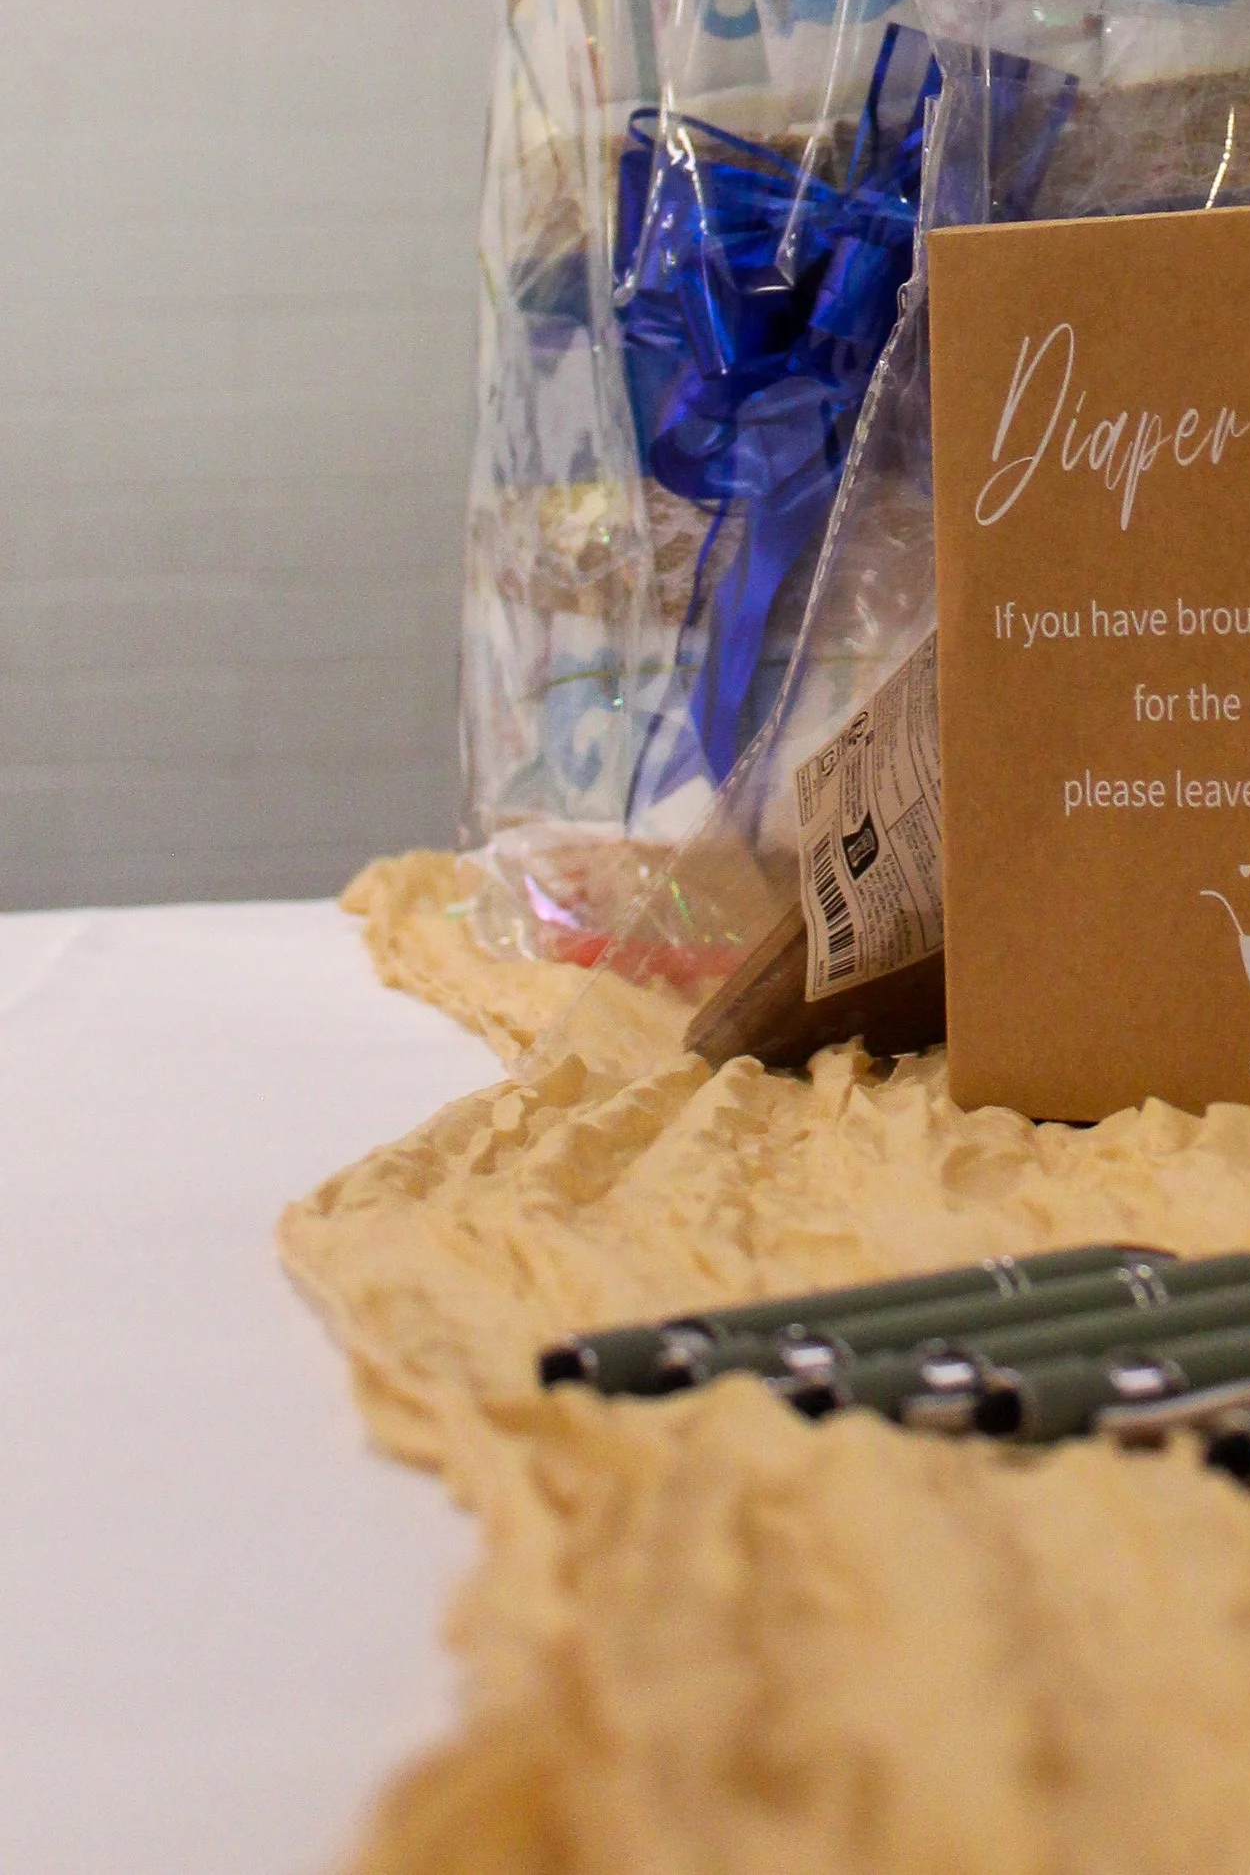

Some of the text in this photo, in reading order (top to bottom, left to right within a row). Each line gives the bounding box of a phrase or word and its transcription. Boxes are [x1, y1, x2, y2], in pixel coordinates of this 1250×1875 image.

[994, 604, 1019, 640] If
[1022, 612, 1081, 647] you
[1090, 600, 1167, 637] have
[1134, 683, 1177, 722] for
[1185, 684, 1243, 721] the
[1063, 770, 1166, 817] please
